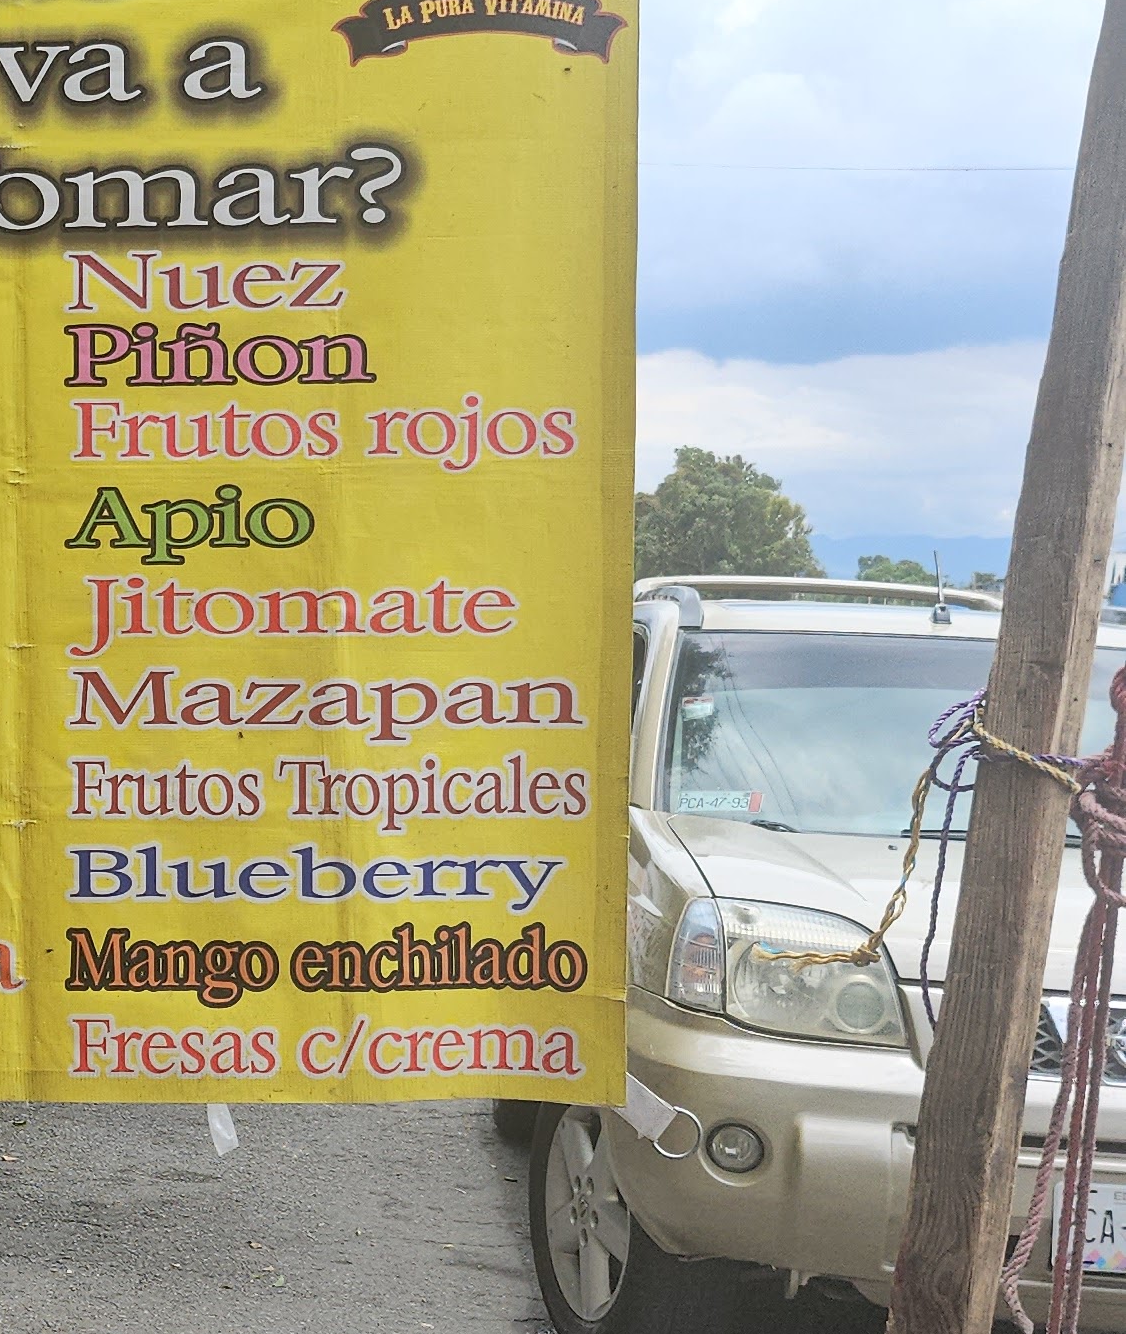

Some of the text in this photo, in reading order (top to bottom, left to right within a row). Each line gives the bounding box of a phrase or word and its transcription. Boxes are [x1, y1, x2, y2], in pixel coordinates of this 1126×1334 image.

[180, 40, 263, 102] a
[68, 252, 346, 313] Nuez
[65, 322, 377, 387] Piñon
[72, 394, 577, 471] Frutos rojos
[65, 485, 316, 565] Apio
[68, 575, 517, 659] Jitomate
[68, 670, 584, 743] Mazapan
[71, 757, 588, 832] Frutos Tropicales
[678, 796, 749, 809] PCA-47-93
[68, 845, 565, 911] Blueberry
[65, 922, 588, 1008] Mango enchilado
[70, 1017, 585, 1076] Fresas c/crema
